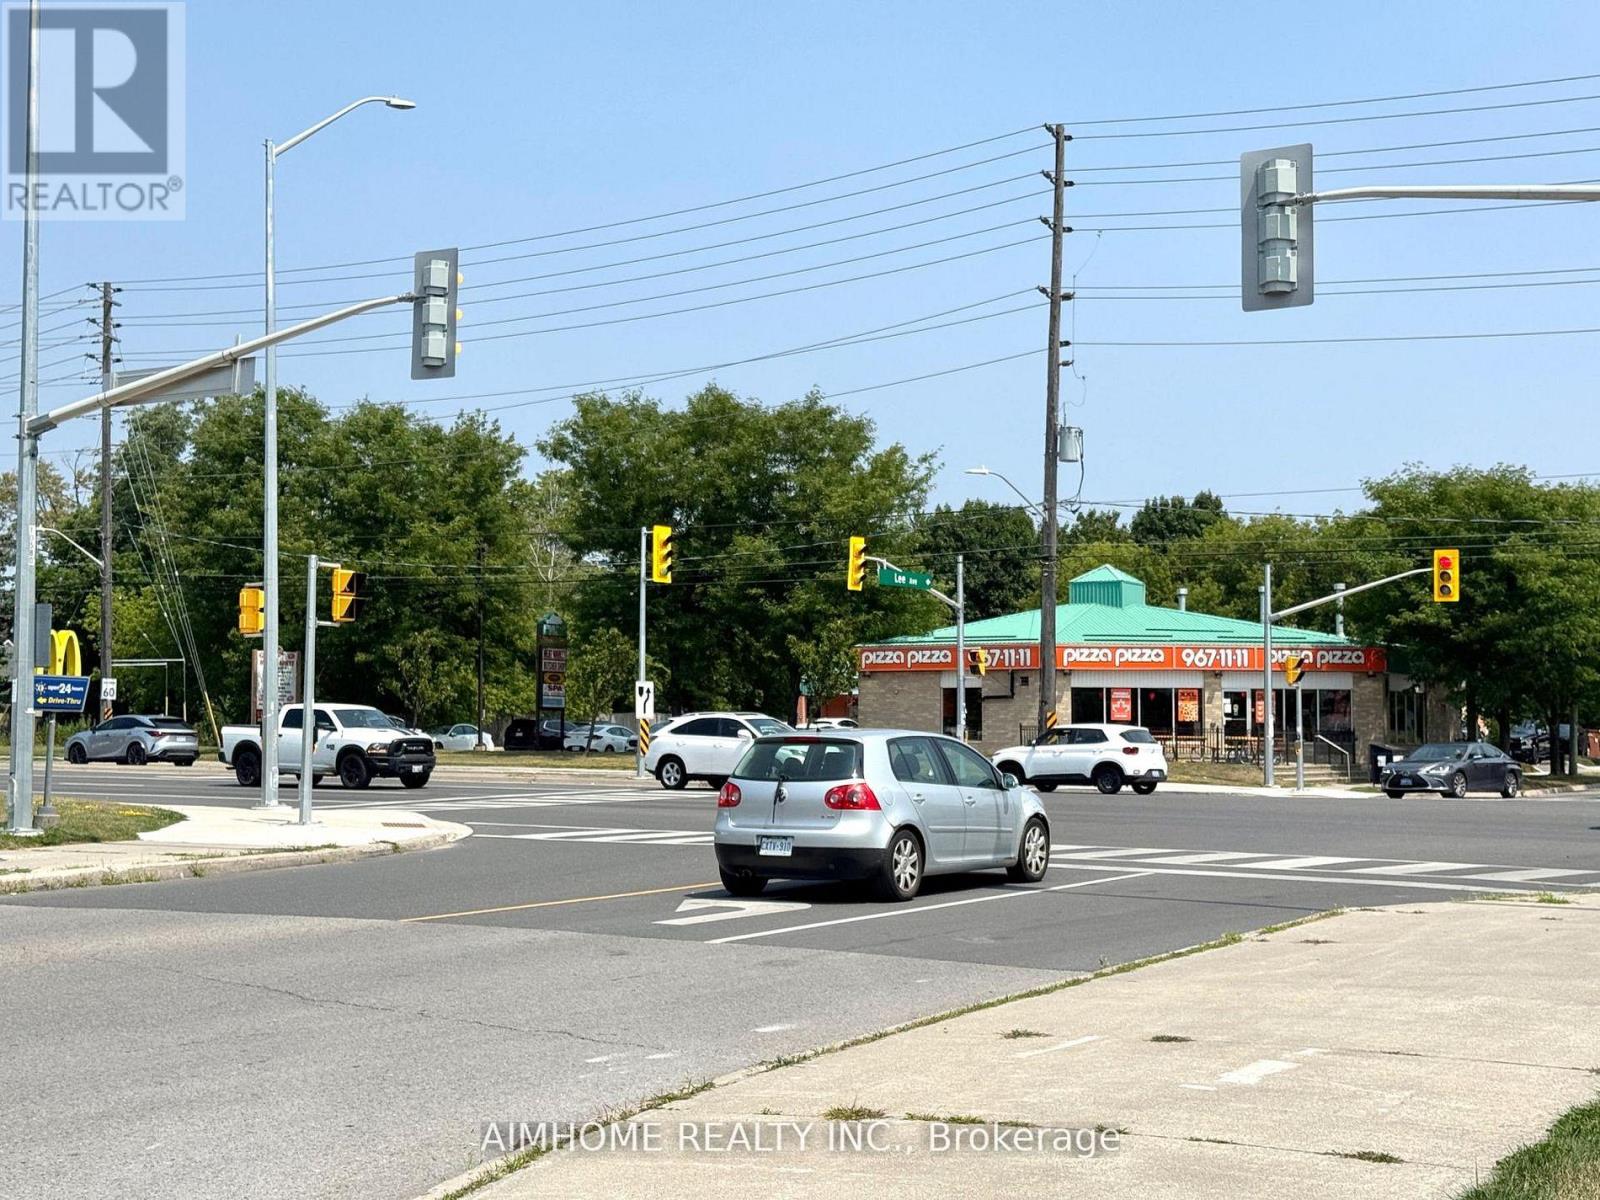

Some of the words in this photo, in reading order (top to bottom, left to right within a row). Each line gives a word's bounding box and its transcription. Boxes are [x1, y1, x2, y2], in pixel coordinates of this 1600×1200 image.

[862, 650, 904, 668] pizza
[907, 650, 952, 668] pizza
[1063, 648, 1112, 667] pizza
[1115, 648, 1164, 667] pizza
[1317, 650, 1365, 668] pizza
[59, 683, 71, 693] 24
[103, 687, 116, 698] 60
